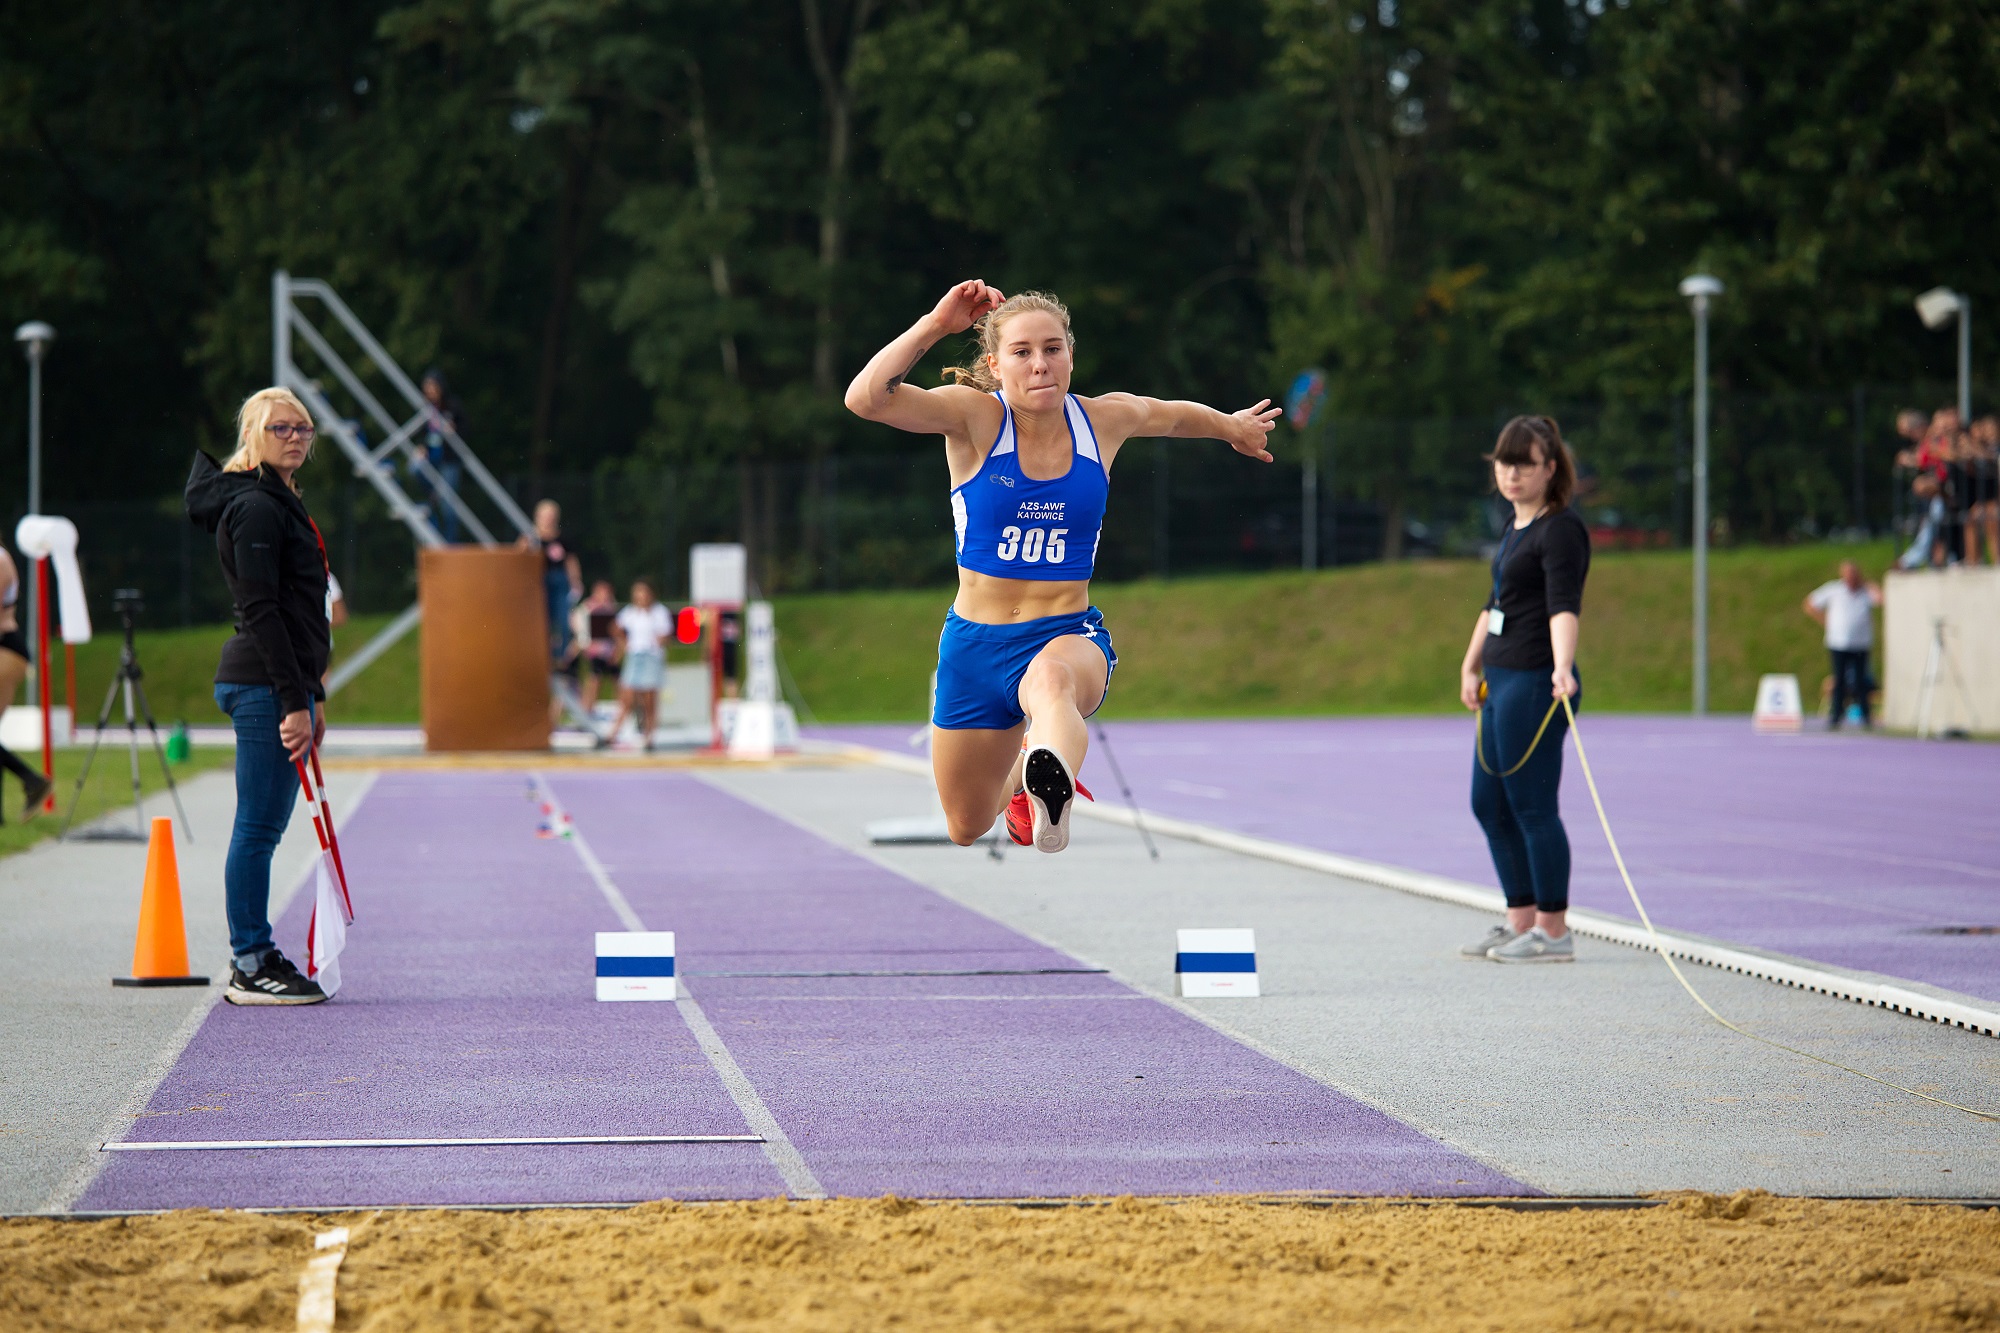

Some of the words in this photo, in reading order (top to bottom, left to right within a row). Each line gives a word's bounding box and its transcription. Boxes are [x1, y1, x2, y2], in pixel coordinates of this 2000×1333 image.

[1019, 501, 1066, 511] AZS-AWF
[1017, 511, 1065, 521] KATOWICE
[997, 525, 1069, 564] 305
